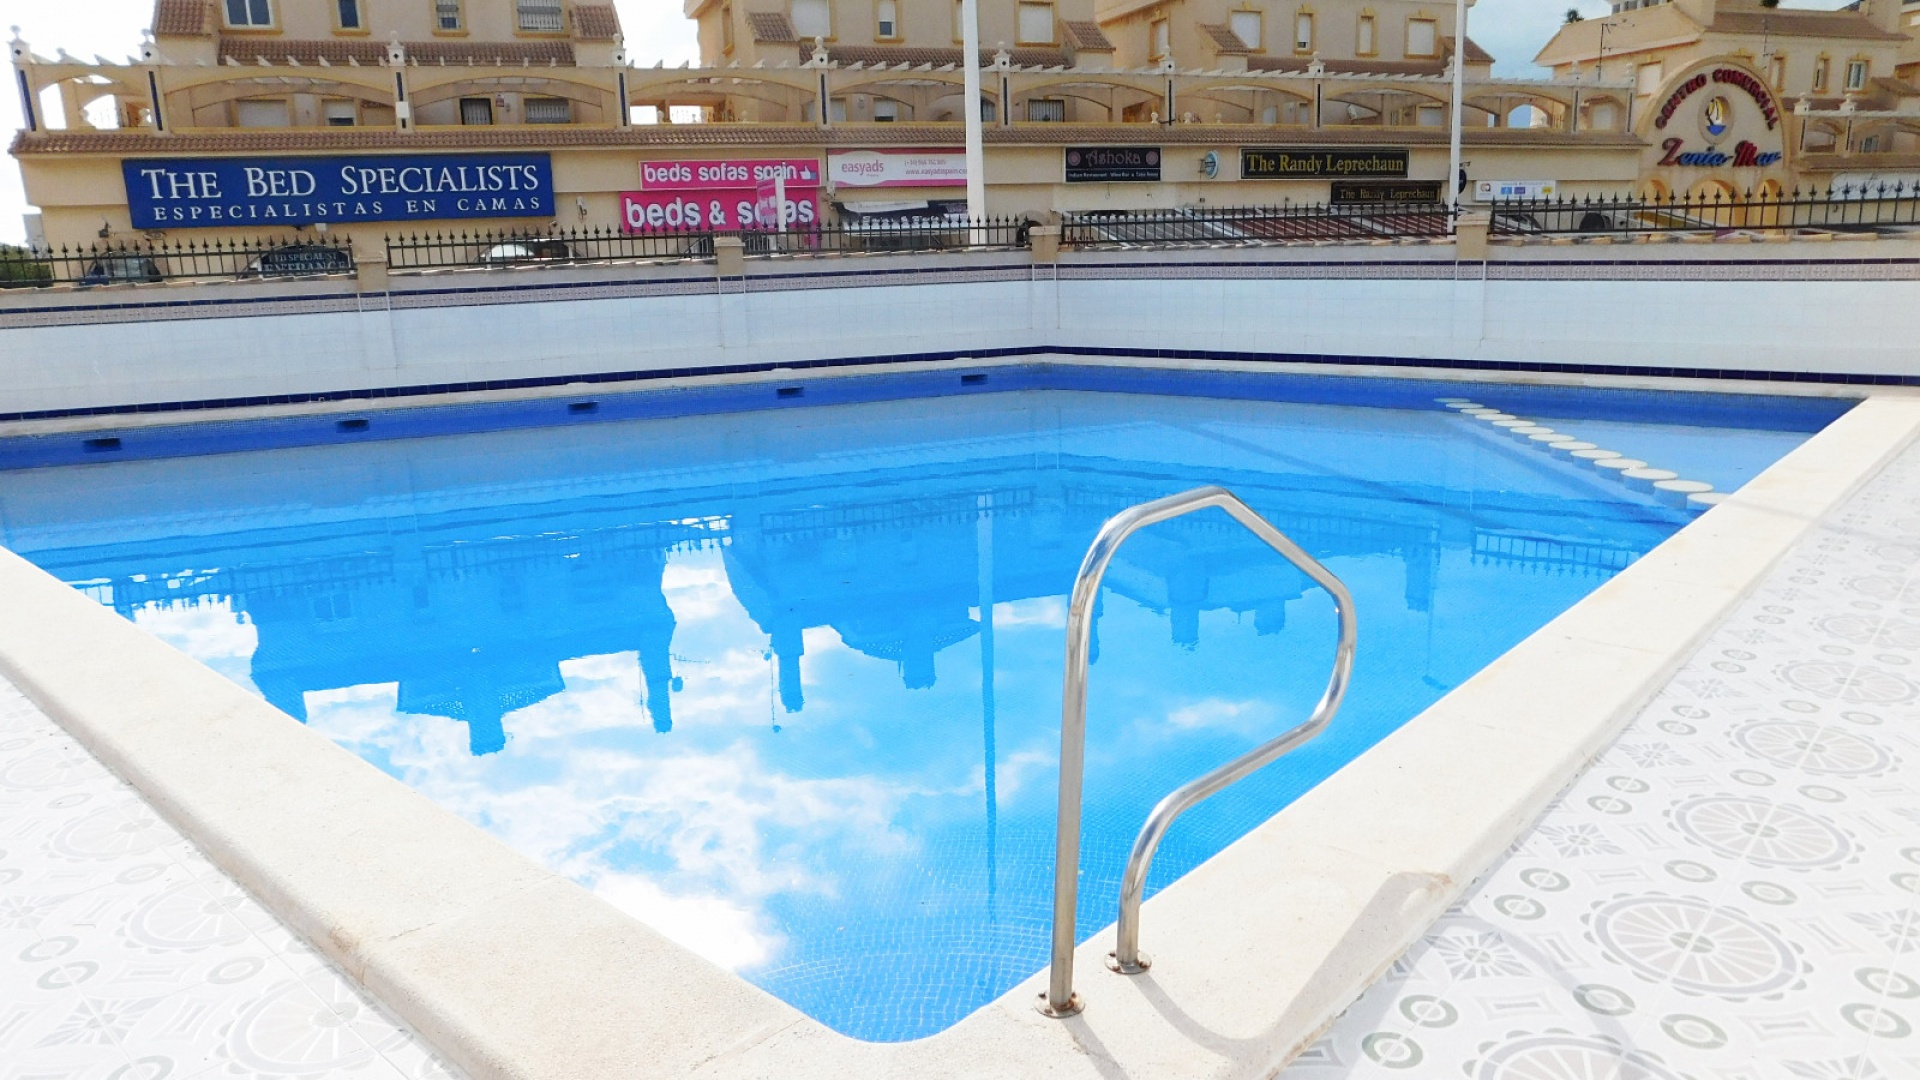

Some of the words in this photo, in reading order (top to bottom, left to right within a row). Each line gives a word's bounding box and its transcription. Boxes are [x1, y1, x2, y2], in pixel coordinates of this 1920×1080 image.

[1655, 73, 1708, 130] CENTRO
[1712, 68, 1779, 131] COMERCIAL
[841, 159, 884, 176] easyads
[1085, 150, 1141, 167] Ashoka
[1246, 154, 1275, 172] The
[1279, 154, 1322, 174] Randy
[1325, 154, 1404, 174] Leprechaun
[141, 168, 222, 199] THE
[243, 167, 316, 197] BED
[341, 165, 539, 195] SPECIALISTS
[643, 162, 692, 183] beds
[697, 162, 749, 181] sofas
[1341, 189, 1356, 199] The
[153, 201, 383, 221] ESPECIALISTAS
[406, 199, 436, 213] EN
[457, 196, 540, 211] CAMAS
[625, 197, 701, 228] beds
[708, 200, 726, 225] &
